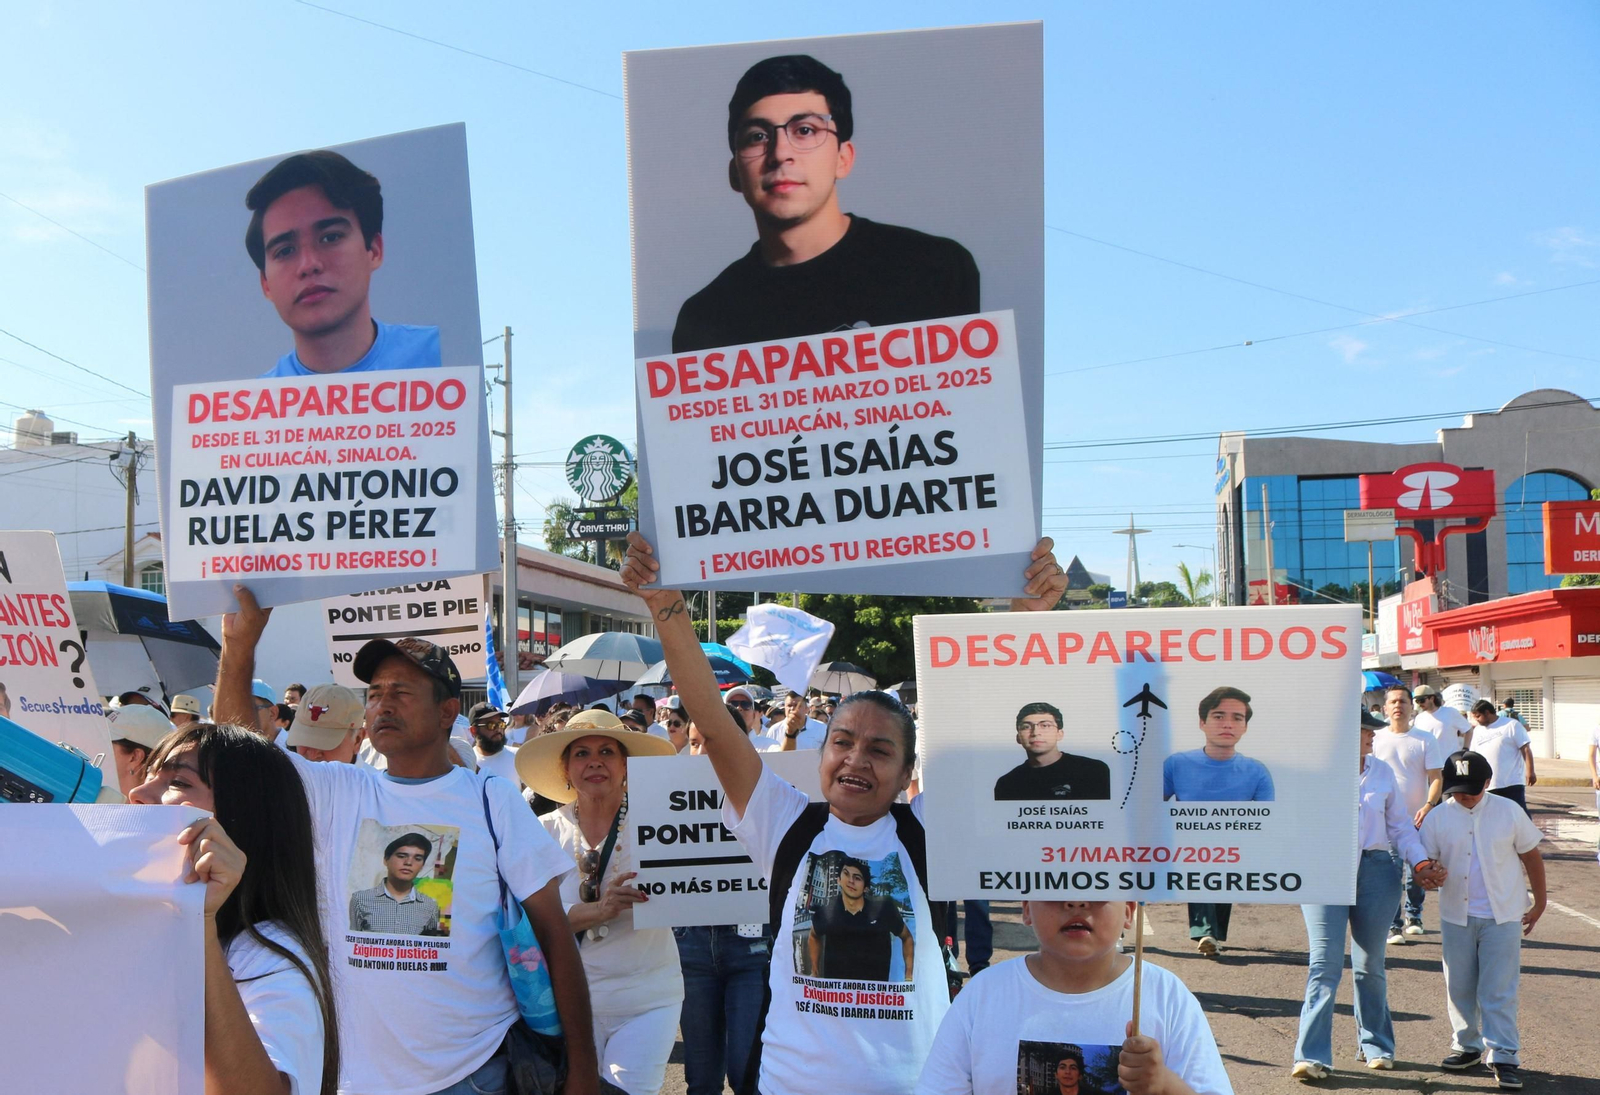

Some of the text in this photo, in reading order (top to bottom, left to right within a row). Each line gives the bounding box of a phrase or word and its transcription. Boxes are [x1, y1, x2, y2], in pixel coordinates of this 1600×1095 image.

[646, 318, 999, 399] DESAPARECIDO
[188, 379, 466, 424] DESAPARECIDO
[669, 367, 992, 421] DESDE EL 31 DE MARZO DEL 2025
[711, 400, 951, 442] EN CULIACÁN, SINALOA.
[192, 421, 455, 448] DESDE EL 31 DE MARZO DEL 2025
[220, 446, 417, 469] EN CULIACÁN, SINALOA.
[711, 424, 959, 490] JOSÉ ISAÍAS
[181, 467, 458, 507] DAVID ANTONIO
[675, 473, 998, 539] IBARRA DUARTE
[189, 500, 436, 545] RUELAS PÉREZ
[580, 523, 628, 533] DRIVE THRU
[308, 552, 331, 567] TU
[830, 541, 859, 563] TU
[1574, 550, 1600, 561] DER
[328, 598, 478, 624] PONTE DE PIE
[333, 652, 352, 663] NO
[442, 642, 482, 656] ISMO
[929, 626, 1348, 668] DESAPARECIDOS
[20, 696, 104, 716] Secuestrados
[1456, 760, 1469, 775] N
[1018, 804, 1088, 817] JOSÉ ISAÍAS
[1170, 808, 1270, 817] DAVID ANTONIO
[1008, 821, 1104, 831] IBARRA DUARTE
[1176, 818, 1262, 832] RUELAS PÉREZ
[1041, 846, 1241, 863] 31/MARZO/2025
[638, 882, 666, 895] NO
[671, 877, 712, 894] MÁS
[717, 879, 742, 892] DE
[979, 871, 1302, 895] EXIJIMOS SU REGRESO
[354, 944, 438, 959] Exigimos justicia
[364, 960, 394, 970] ANTONIO
[397, 962, 428, 971] RUELAS
[804, 985, 904, 1006] Exigimos justicia
[805, 979, 841, 989] ESTUDIANTE
[843, 982, 866, 990] AHORA
[868, 983, 876, 991] ES
[878, 984, 887, 992] UN
[812, 1003, 838, 1017] ISAIAS
[841, 1007, 876, 1019] IBARRA
[878, 1009, 914, 1020] DUARTE
